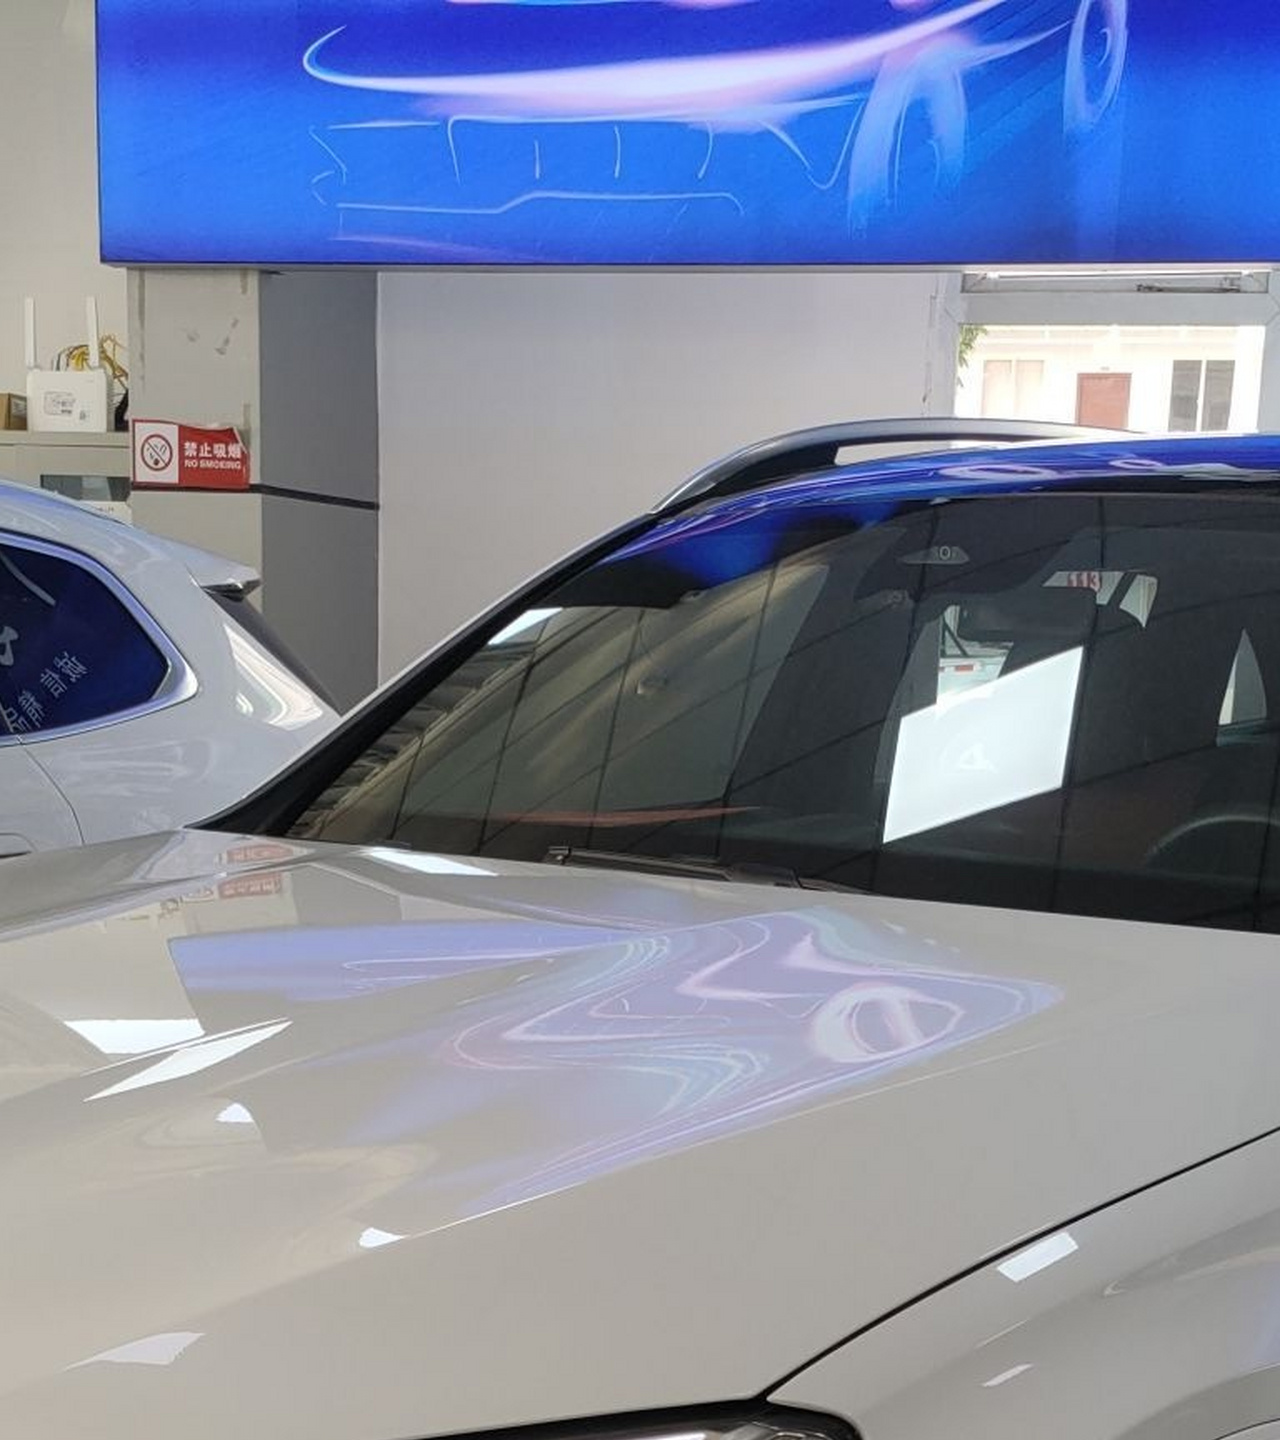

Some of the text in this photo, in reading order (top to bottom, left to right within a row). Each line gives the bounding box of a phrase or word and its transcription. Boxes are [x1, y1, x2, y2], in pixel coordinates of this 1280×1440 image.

[184, 441, 242, 459] 禁止吸烟
[184, 459, 241, 470] NO SMOKING
